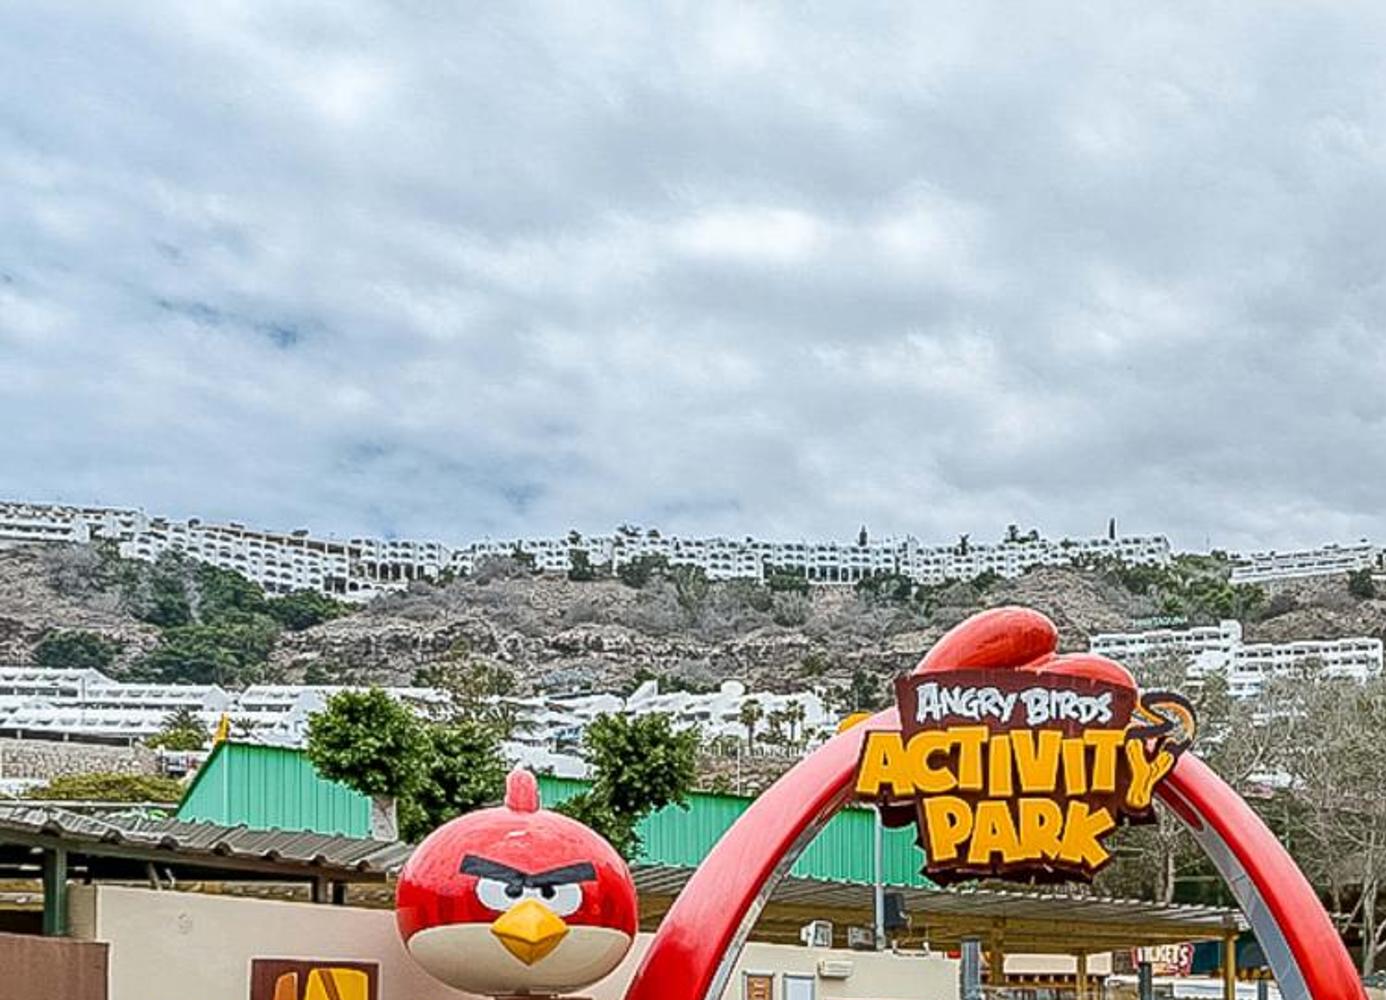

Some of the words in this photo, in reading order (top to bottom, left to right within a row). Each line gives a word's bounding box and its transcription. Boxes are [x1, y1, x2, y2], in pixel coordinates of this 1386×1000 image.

[915, 682, 1020, 724] ANGRY
[1020, 685, 1114, 725] BIRDS
[855, 725, 1175, 809] ACTIVITY
[922, 796, 1116, 868] PARK
